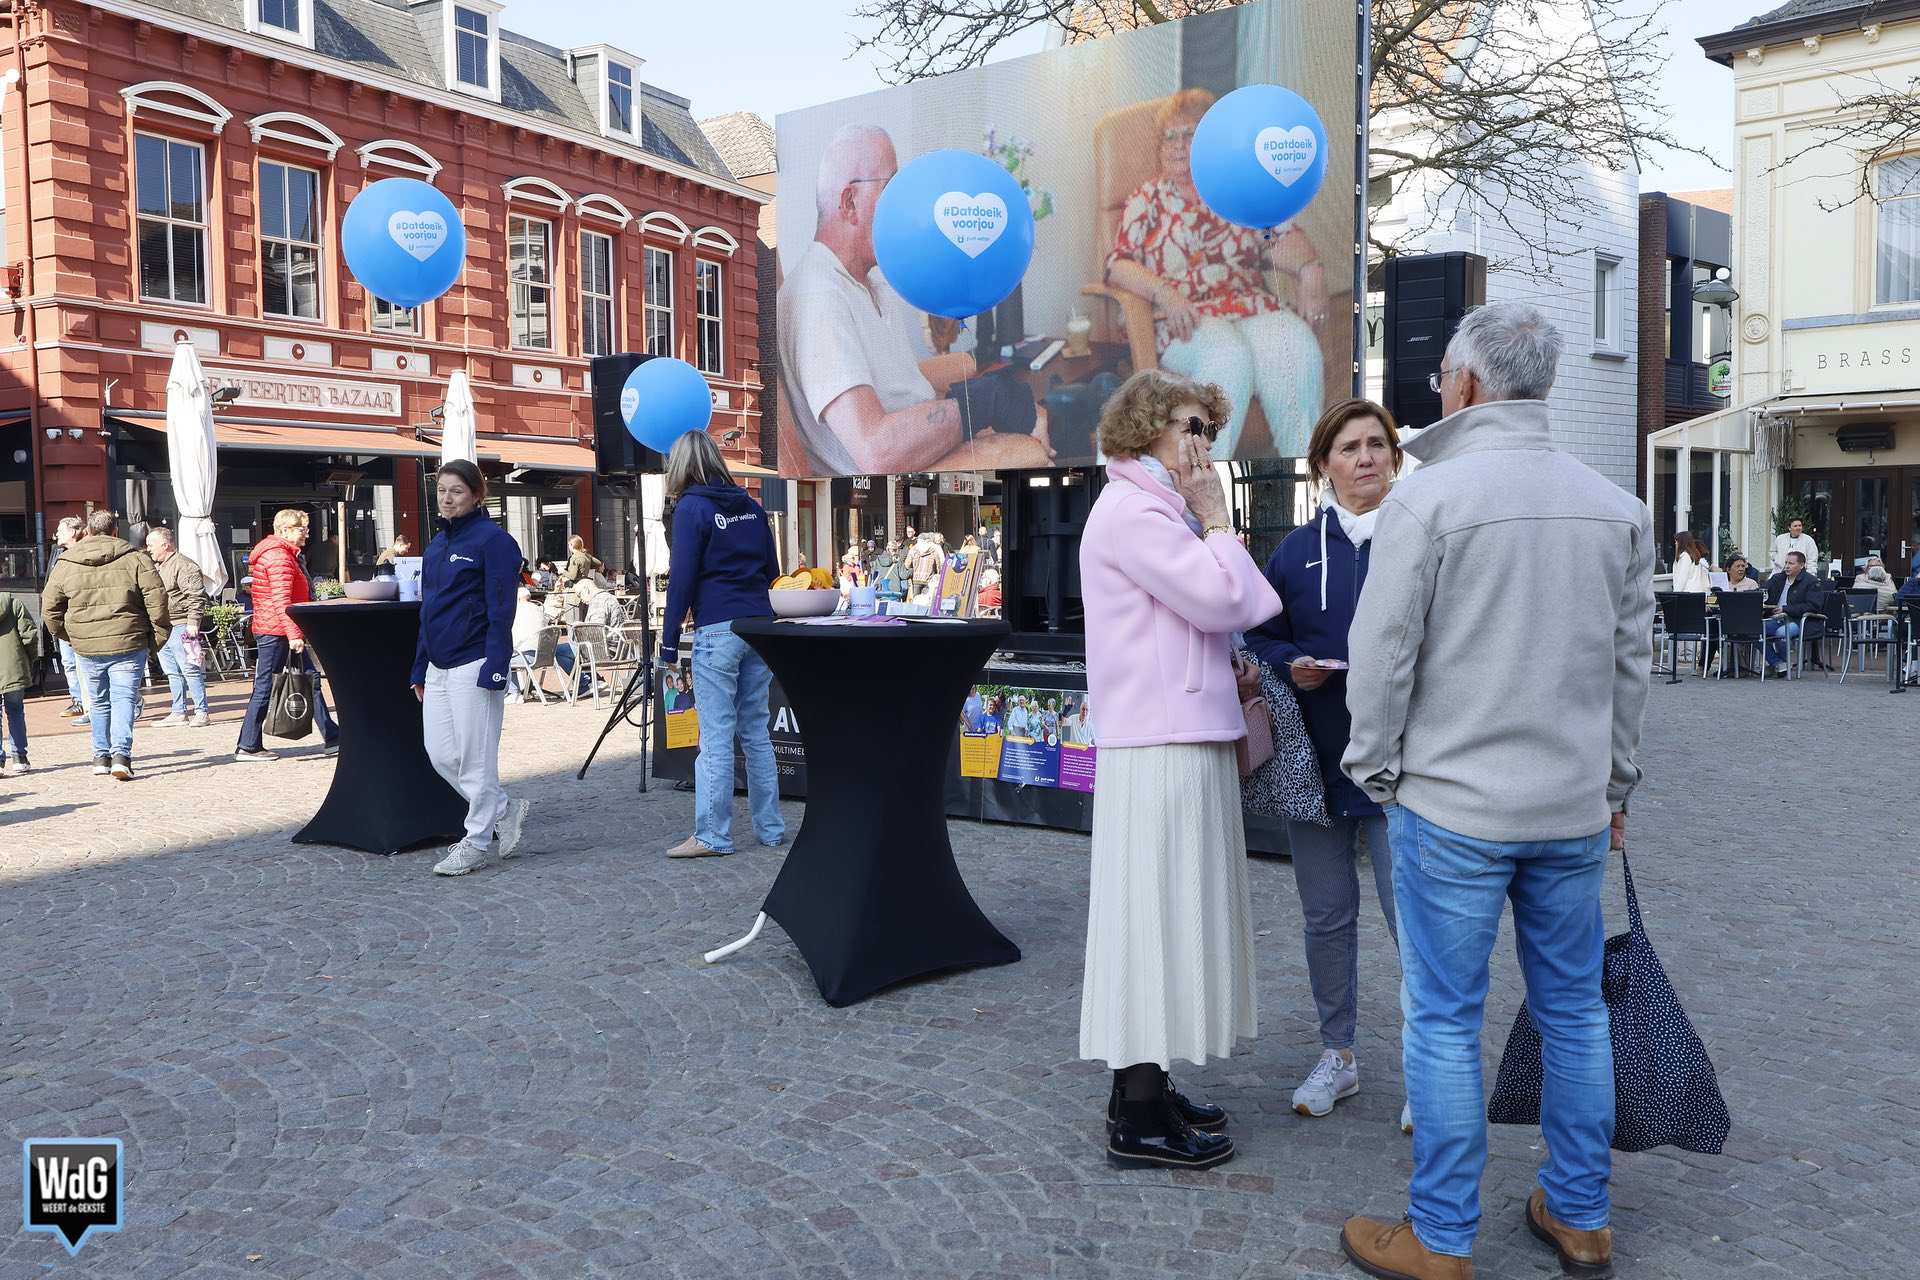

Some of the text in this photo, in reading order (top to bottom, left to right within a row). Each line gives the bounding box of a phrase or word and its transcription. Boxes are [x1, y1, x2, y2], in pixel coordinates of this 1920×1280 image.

[1263, 138, 1312, 151] #Datdoeik
[1271, 150, 1306, 163] voorjou
[943, 205, 1002, 218] #Datdoeik
[396, 221, 443, 232] #Datdoeik
[952, 218, 994, 231] voorjou
[403, 231, 437, 240] voorjou
[1817, 347, 1912, 369] BRASS
[328, 387, 395, 412] BAZAAR
